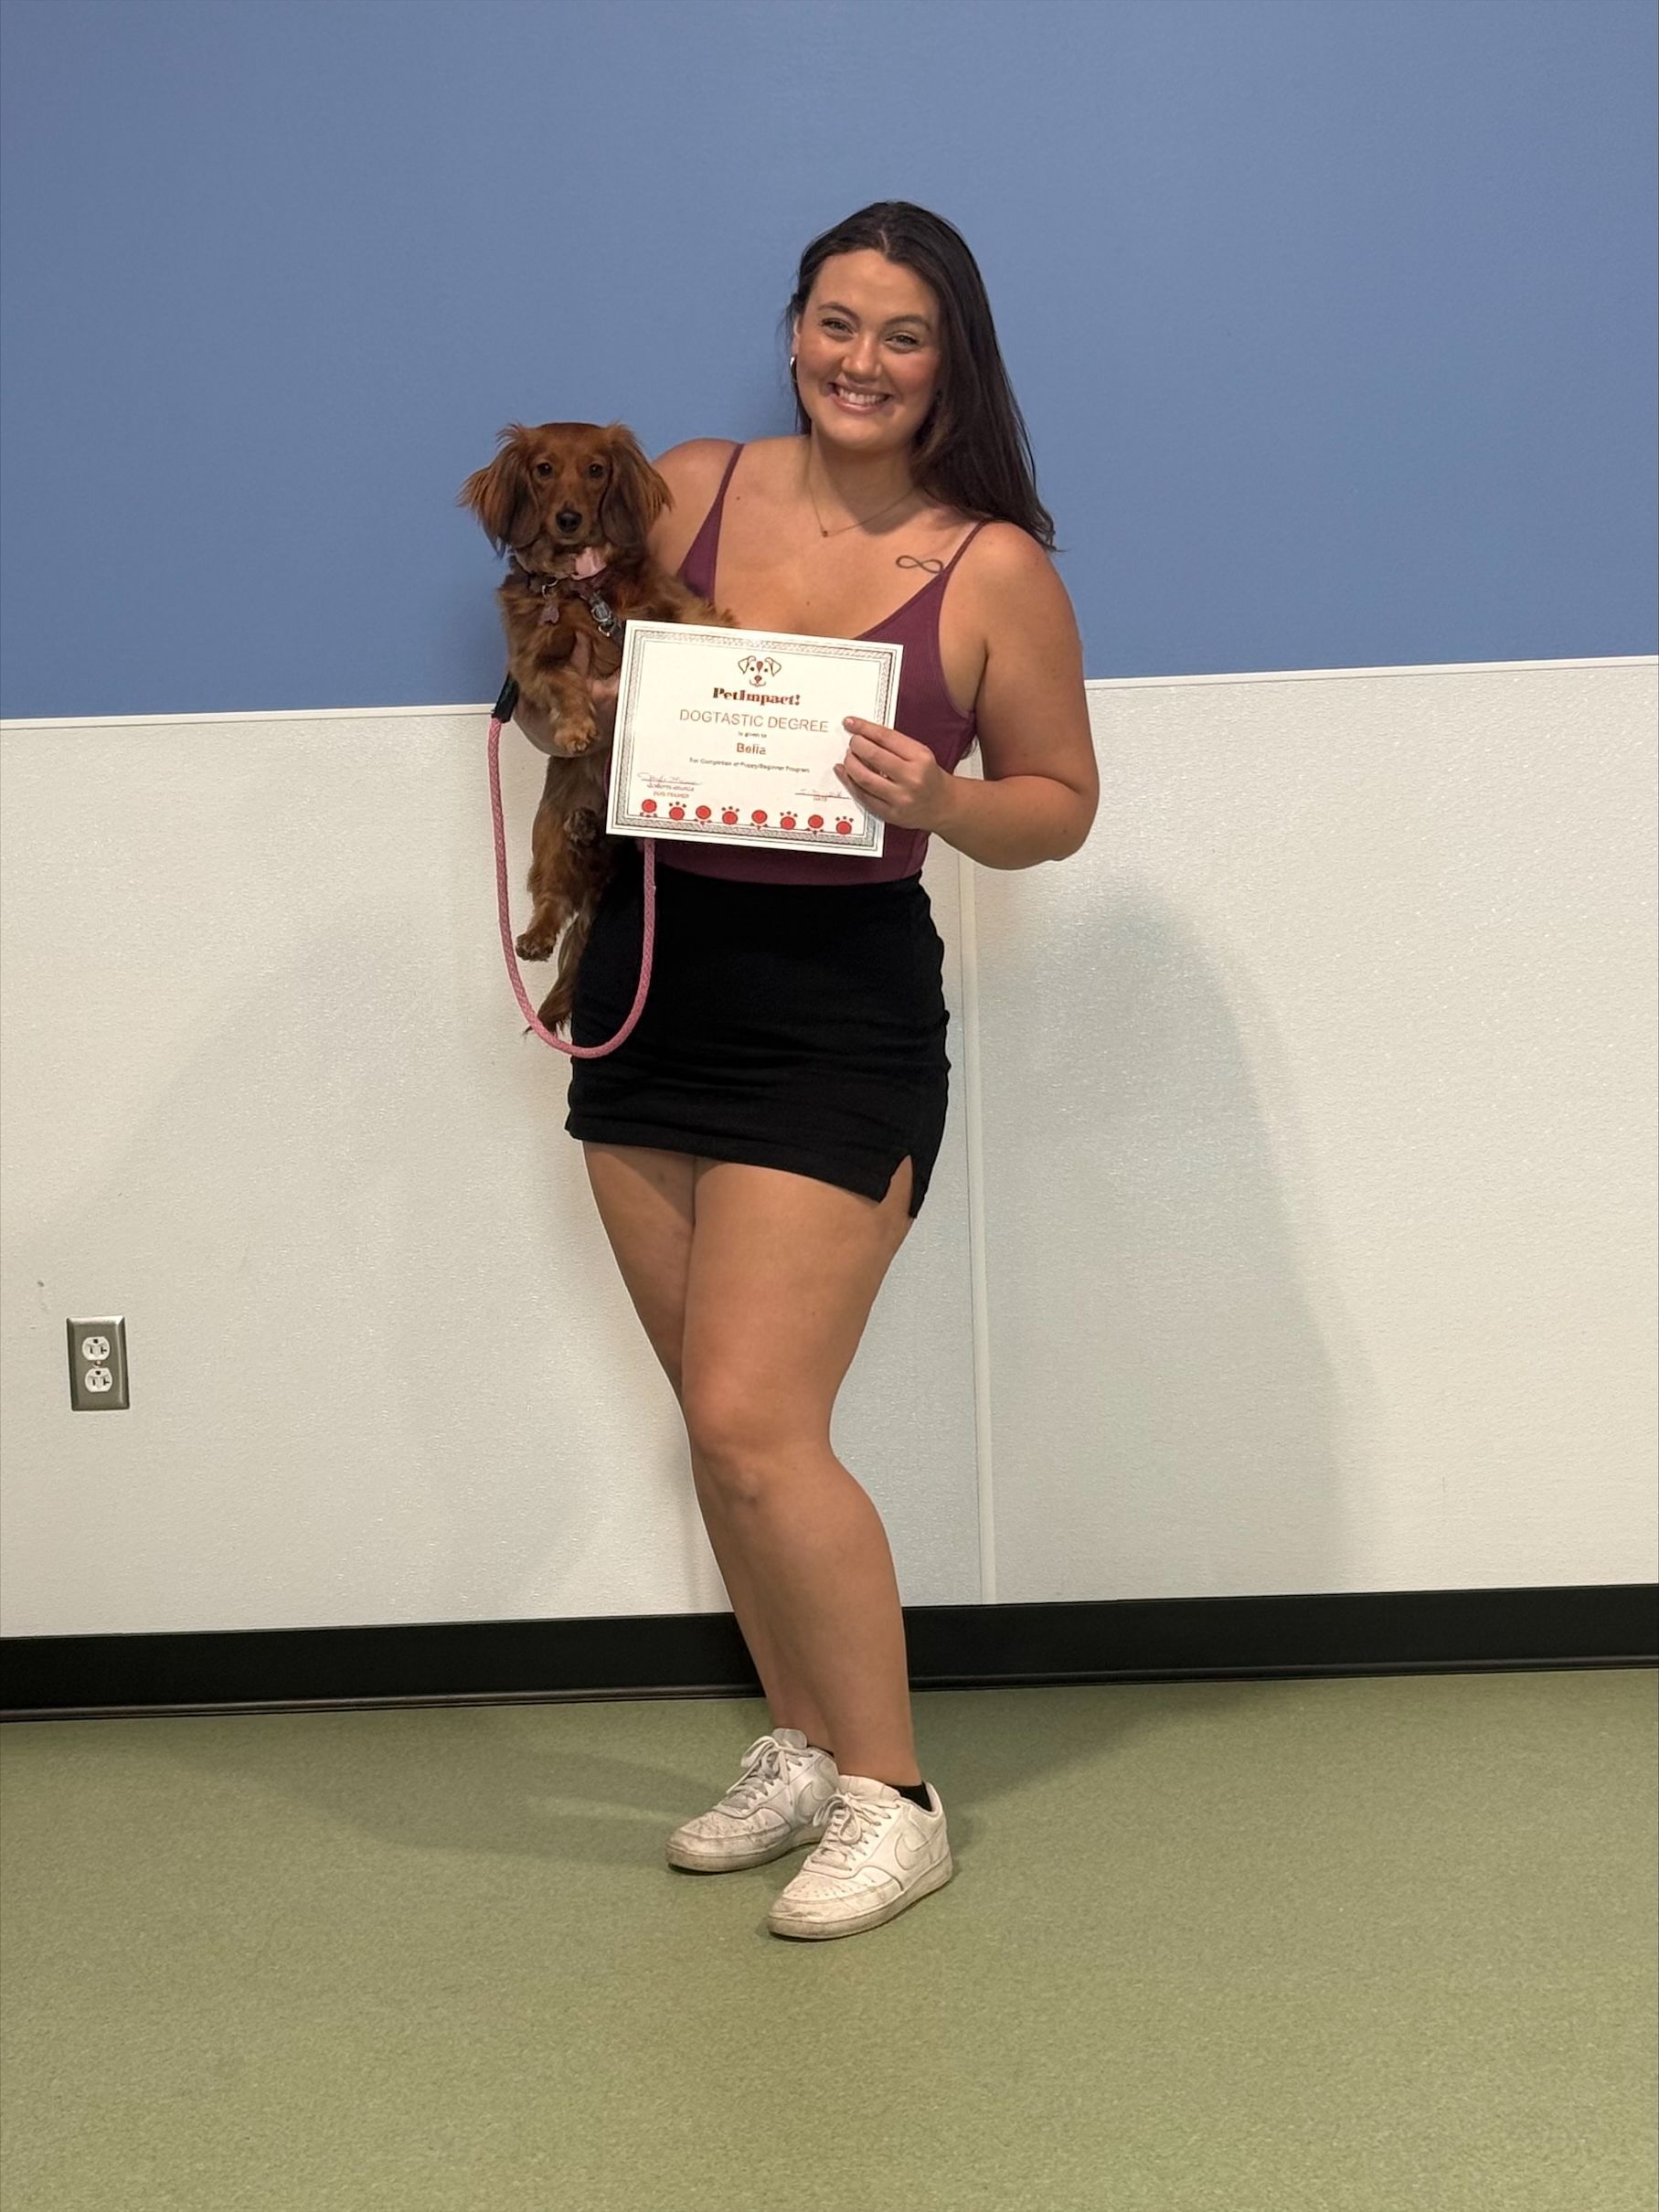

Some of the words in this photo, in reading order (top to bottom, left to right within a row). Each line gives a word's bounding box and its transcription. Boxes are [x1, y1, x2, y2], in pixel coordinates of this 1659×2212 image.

[712, 686, 801, 706] PetImpact!
[679, 708, 764, 728] DOGTASTIC
[768, 716, 829, 732] DEGREE
[700, 758, 732, 767] Completion
